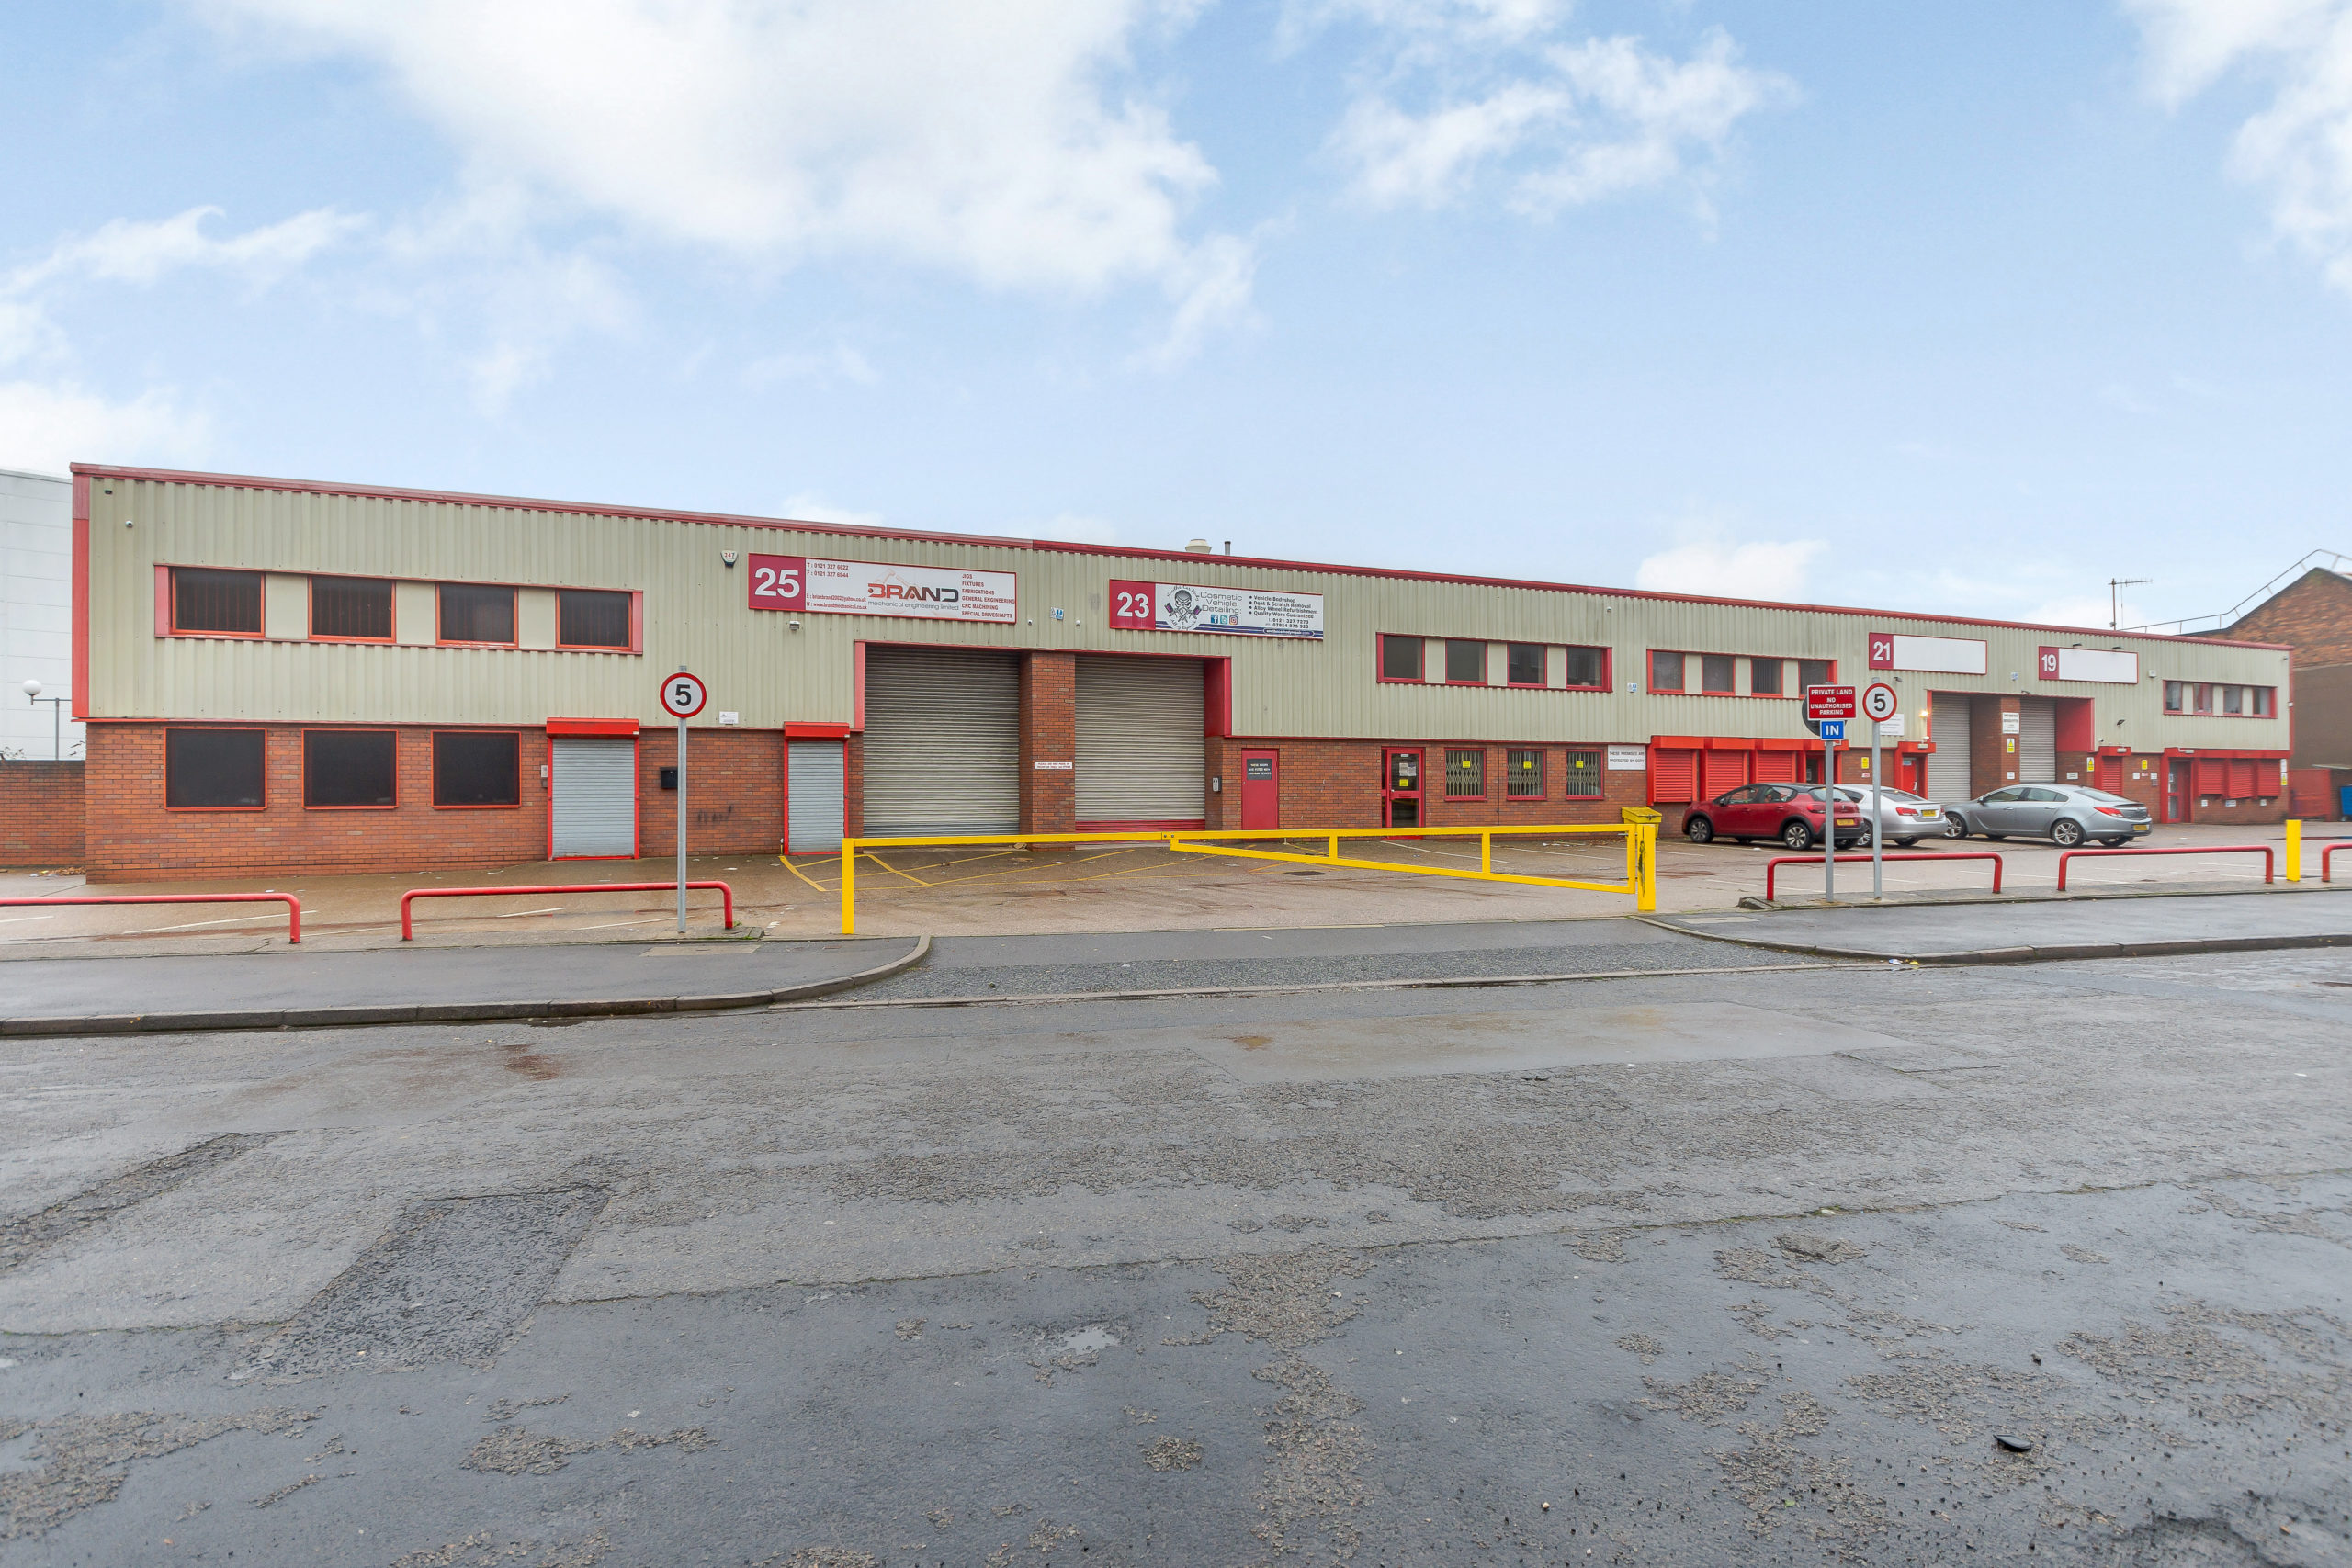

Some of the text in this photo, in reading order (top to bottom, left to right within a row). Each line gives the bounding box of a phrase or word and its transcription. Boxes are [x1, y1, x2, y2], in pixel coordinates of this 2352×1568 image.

[754, 567, 800, 598] 25
[868, 583, 958, 602] BRAND
[1201, 592, 1242, 602] Cosmetic
[1116, 592, 1149, 618] 23
[1202, 605, 1241, 615] Detailing:
[1873, 641, 1890, 660] 21
[2041, 654, 2057, 672] 19
[675, 684, 692, 706] 5
[1874, 693, 1886, 712] 5
[1826, 725, 1839, 736] IN
